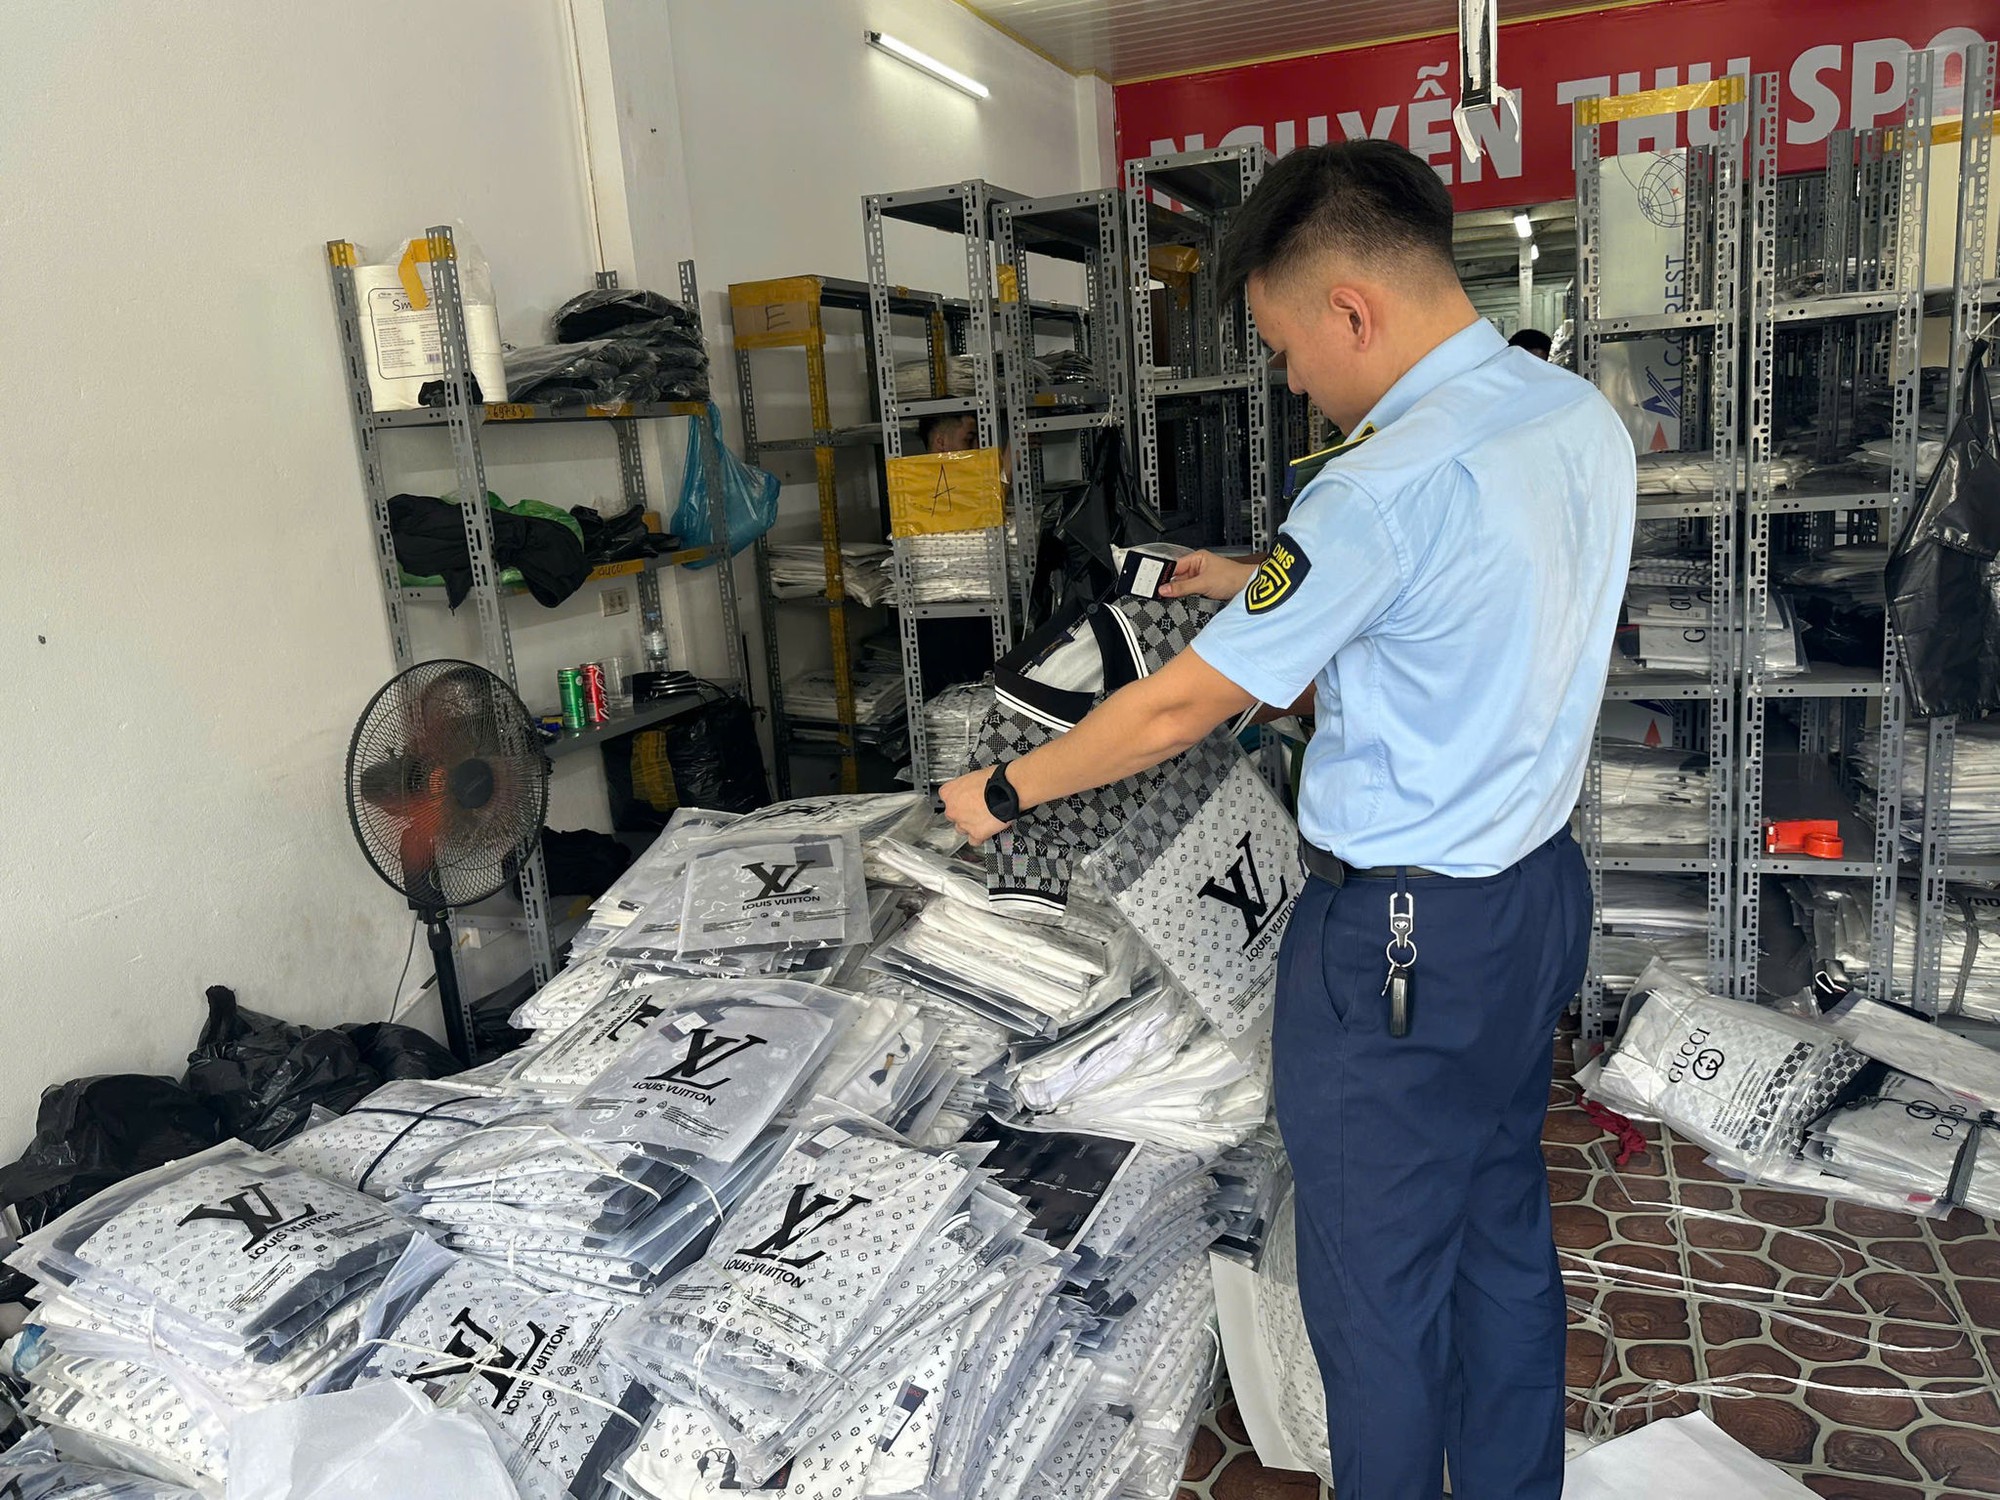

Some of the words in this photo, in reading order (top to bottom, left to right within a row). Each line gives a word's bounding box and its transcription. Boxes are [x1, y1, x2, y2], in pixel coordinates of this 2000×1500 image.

[1556, 57, 1750, 170] THU
[767, 305, 792, 331] E
[931, 463, 957, 518] A
[1271, 542, 1296, 570] DMS
[742, 899, 772, 911] LOUIS
[774, 895, 821, 906] VUITTON
[1245, 934, 1273, 963] LOUIS
[1668, 1027, 1711, 1084] GUCCI
[632, 1081, 667, 1093] LOUIS
[666, 1083, 717, 1106] VUITTON
[1931, 1104, 1968, 1141] GCCI
[247, 1231, 288, 1260] LOUIS
[287, 1210, 342, 1234] VUITTON
[723, 1258, 752, 1272] LOUIS
[751, 1262, 807, 1289] VUITTON
[501, 1379, 533, 1417] LOUIS
[530, 1324, 570, 1377] VUITTON
